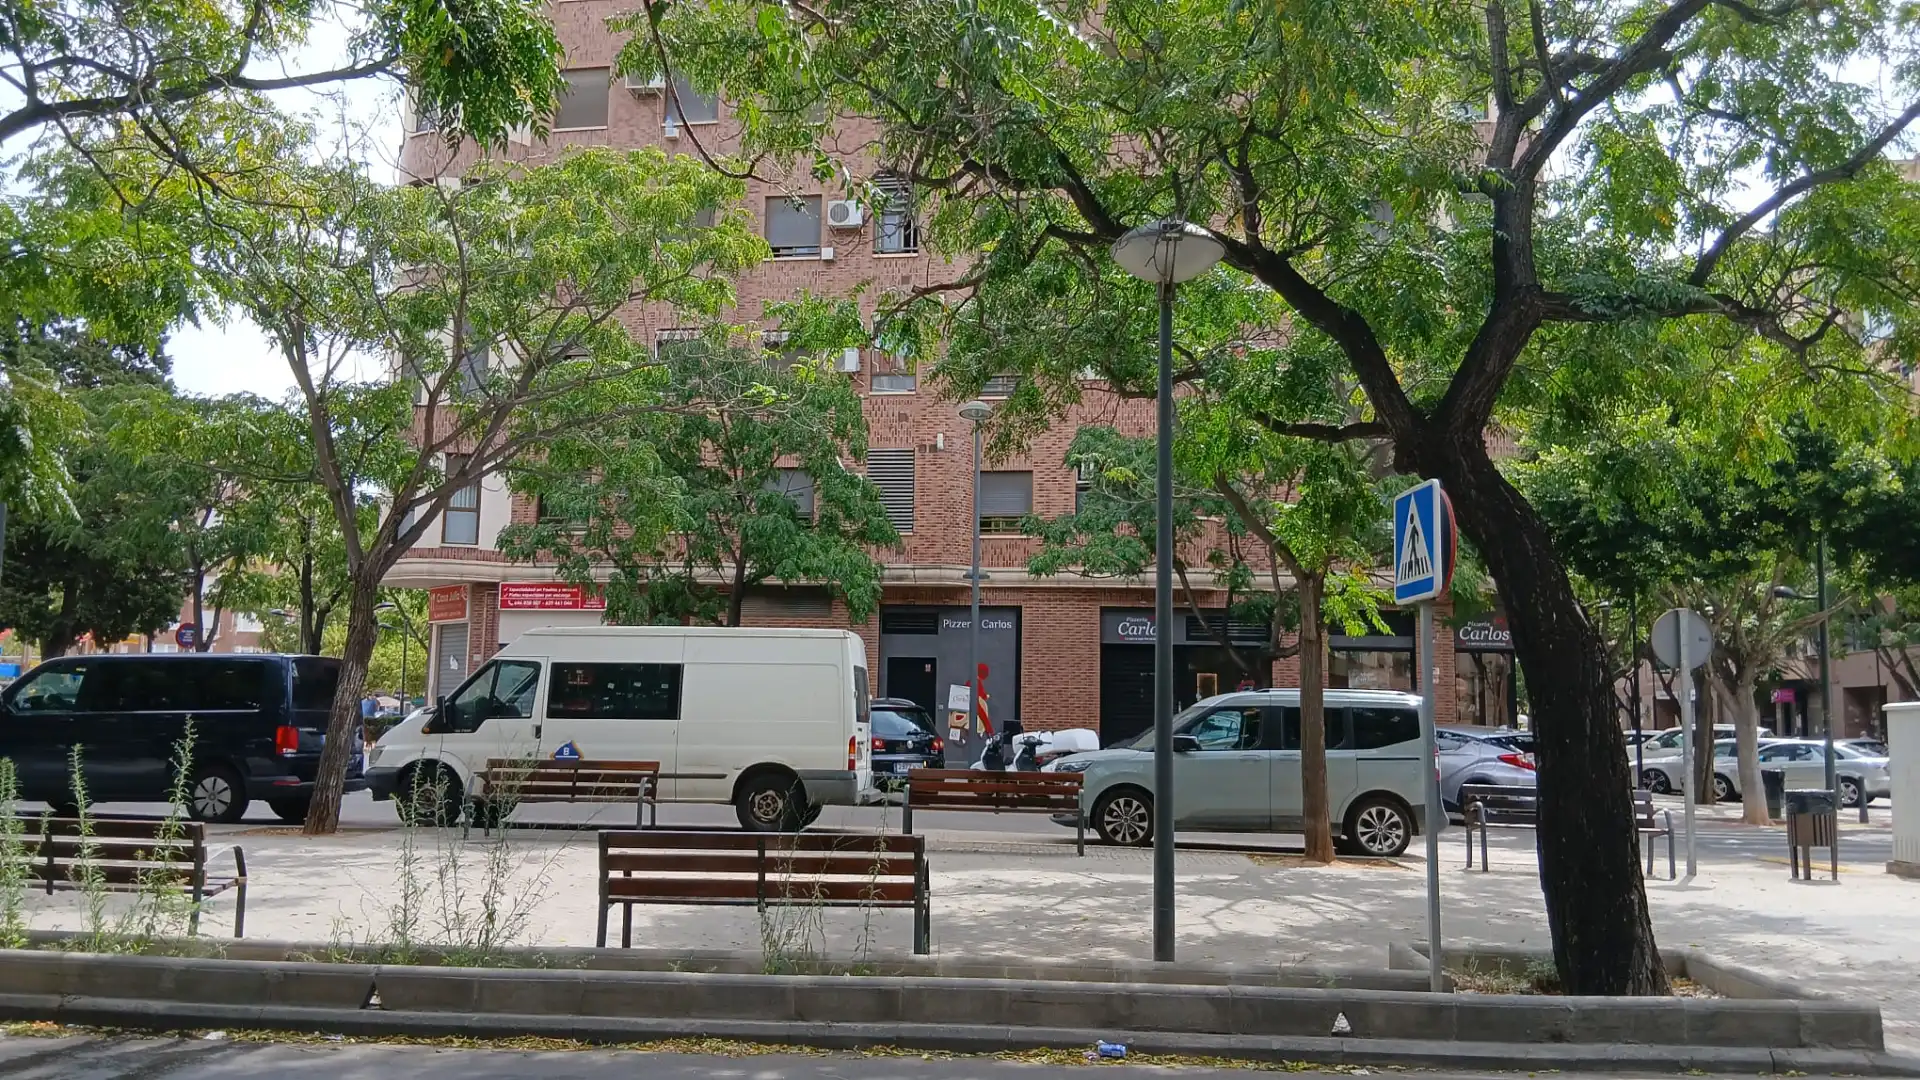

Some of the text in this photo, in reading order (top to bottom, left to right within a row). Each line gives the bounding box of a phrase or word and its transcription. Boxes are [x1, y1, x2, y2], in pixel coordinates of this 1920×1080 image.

[943, 619, 1012, 629] Pizzer Carlos
[1118, 621, 1157, 636] Carlo
[1459, 626, 1510, 641] Carlos
